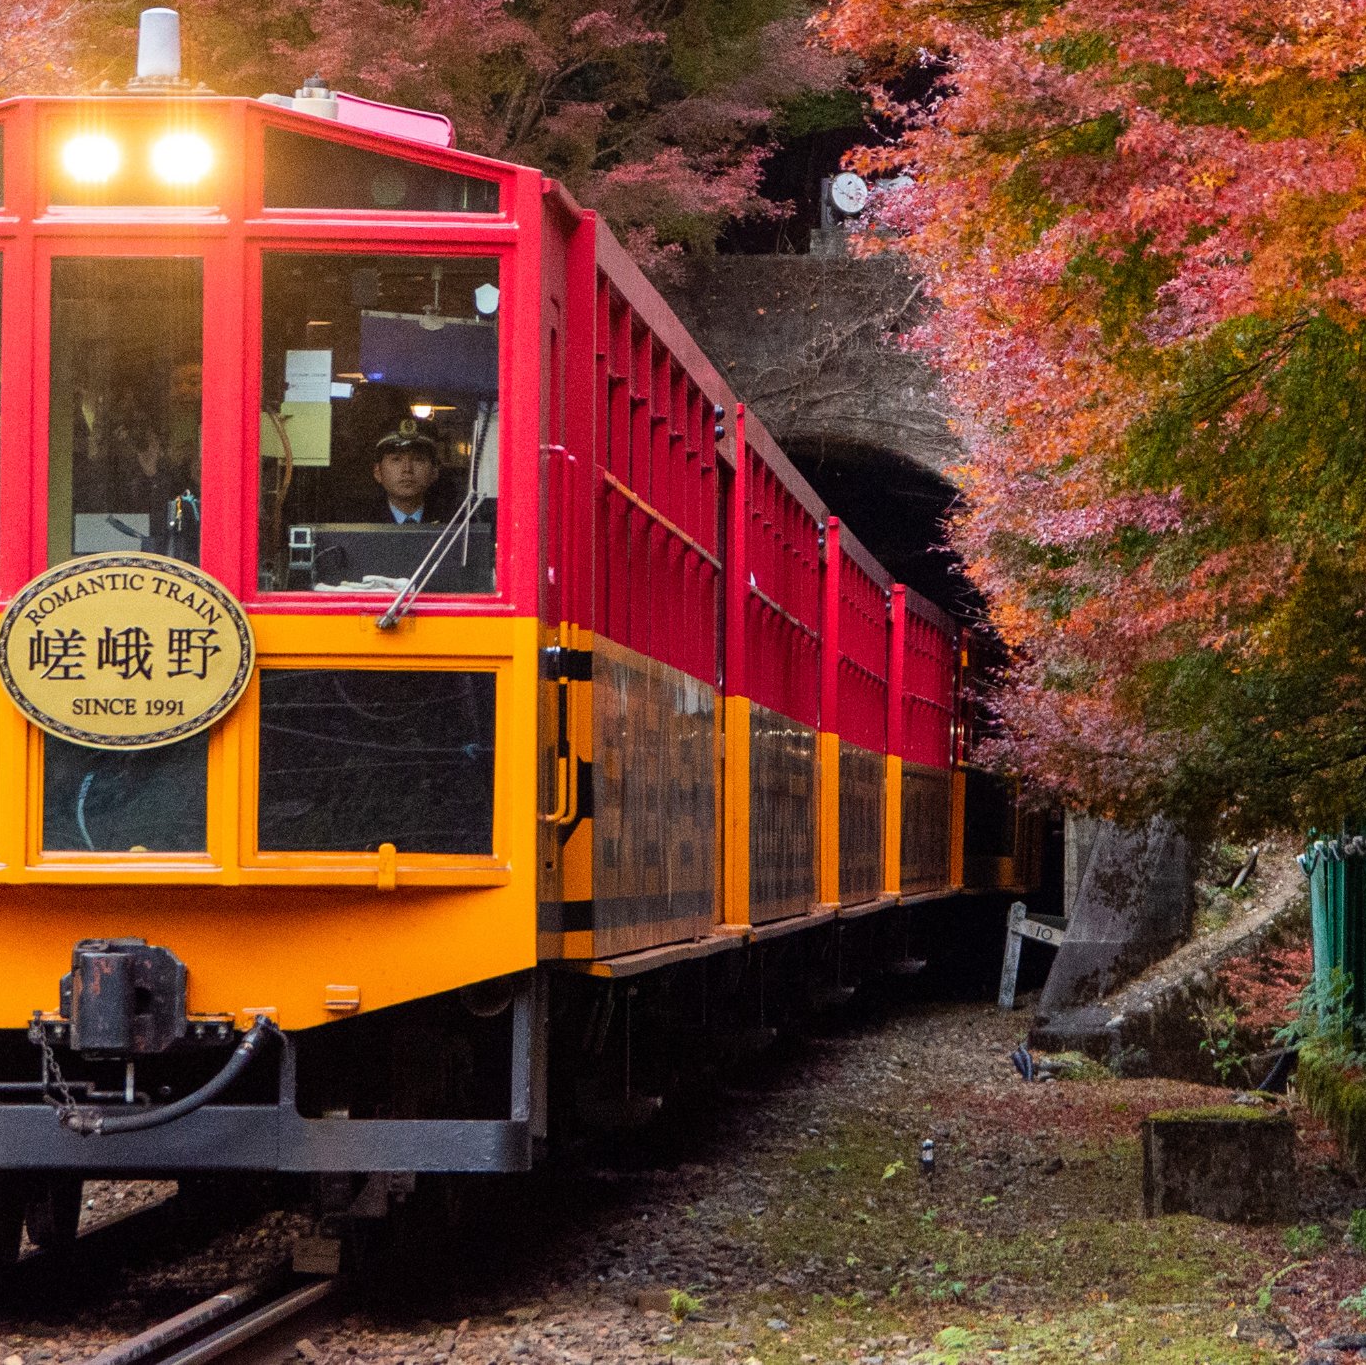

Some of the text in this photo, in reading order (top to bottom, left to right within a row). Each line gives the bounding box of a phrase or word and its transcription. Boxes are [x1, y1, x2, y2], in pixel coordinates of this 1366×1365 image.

[24, 573, 223, 627] ROMANTIC TRAIN
[28, 626, 222, 681] 嵯峨野
[72, 698, 185, 716] SINCE 1991
[1035, 925, 1053, 940] 10
